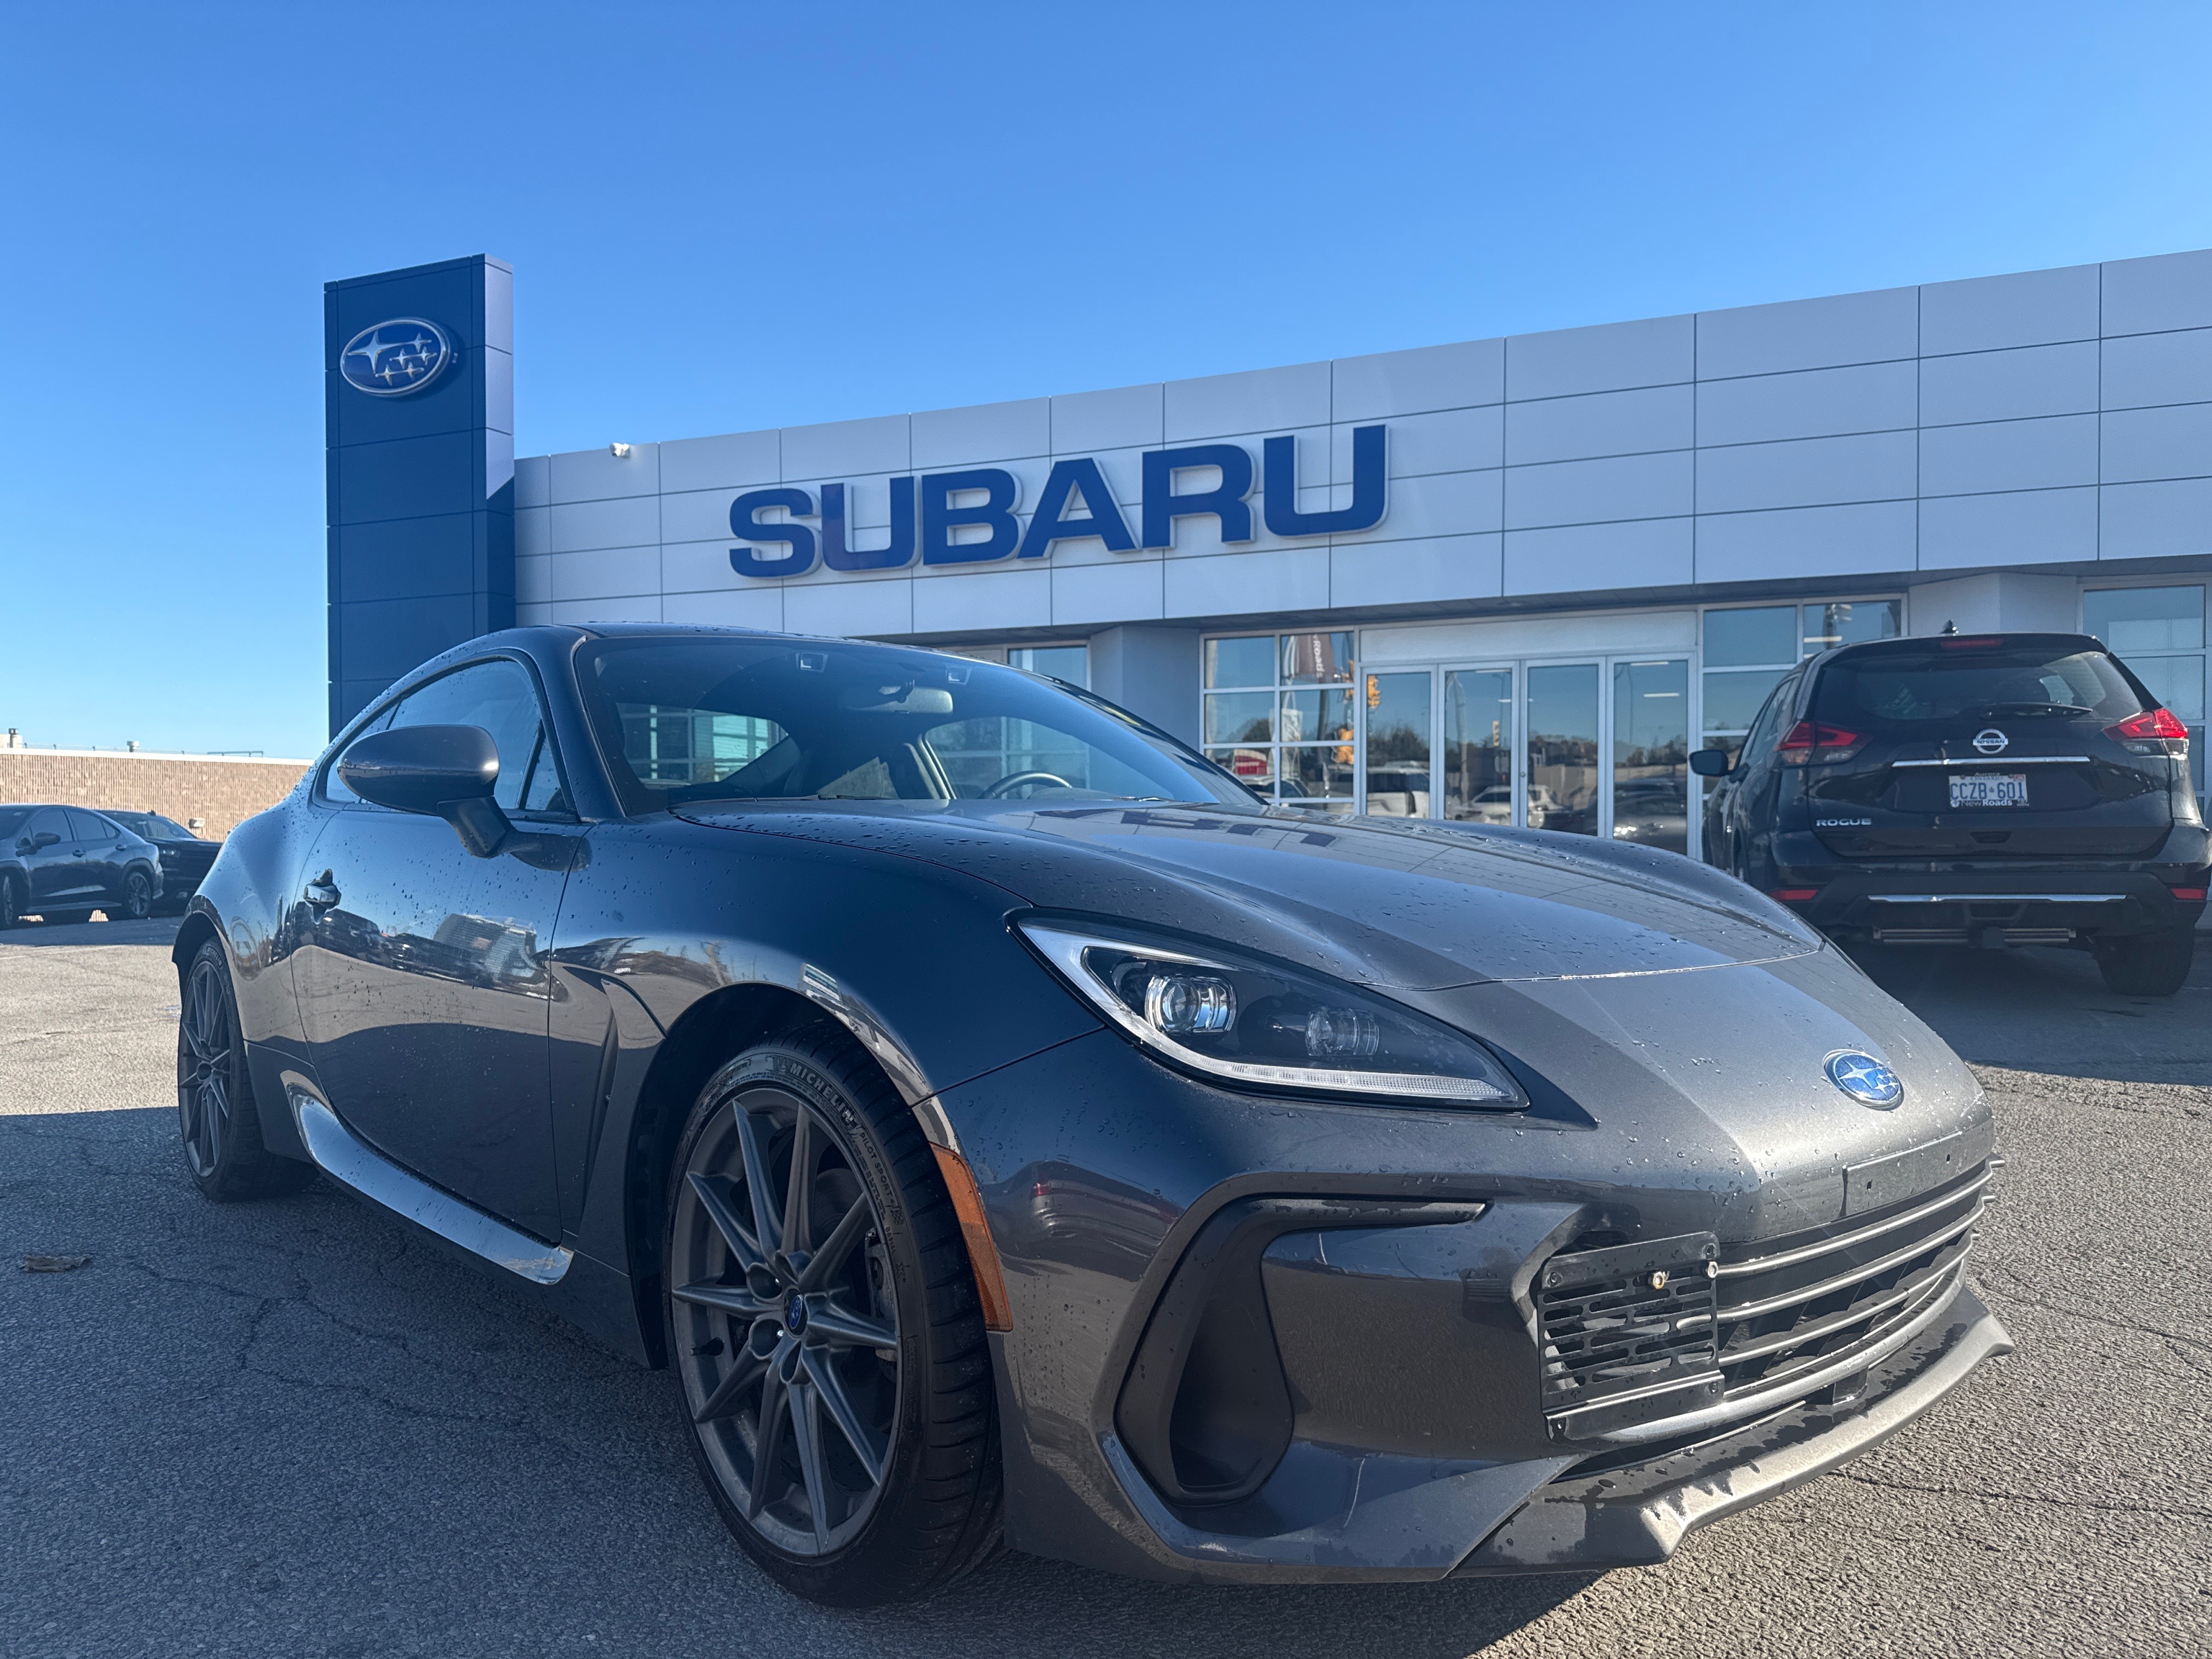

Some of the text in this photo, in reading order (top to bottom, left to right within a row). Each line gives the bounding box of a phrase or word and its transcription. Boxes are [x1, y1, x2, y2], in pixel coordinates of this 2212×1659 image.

[729, 424, 1387, 580] SUBARU
[1950, 782, 2025, 799] CCZB 601
[1816, 818, 1871, 827] ROGUE
[789, 1063, 855, 1124] MICHELIN
[859, 1132, 877, 1159] PILOT
[874, 1162, 893, 1197] SPORT
